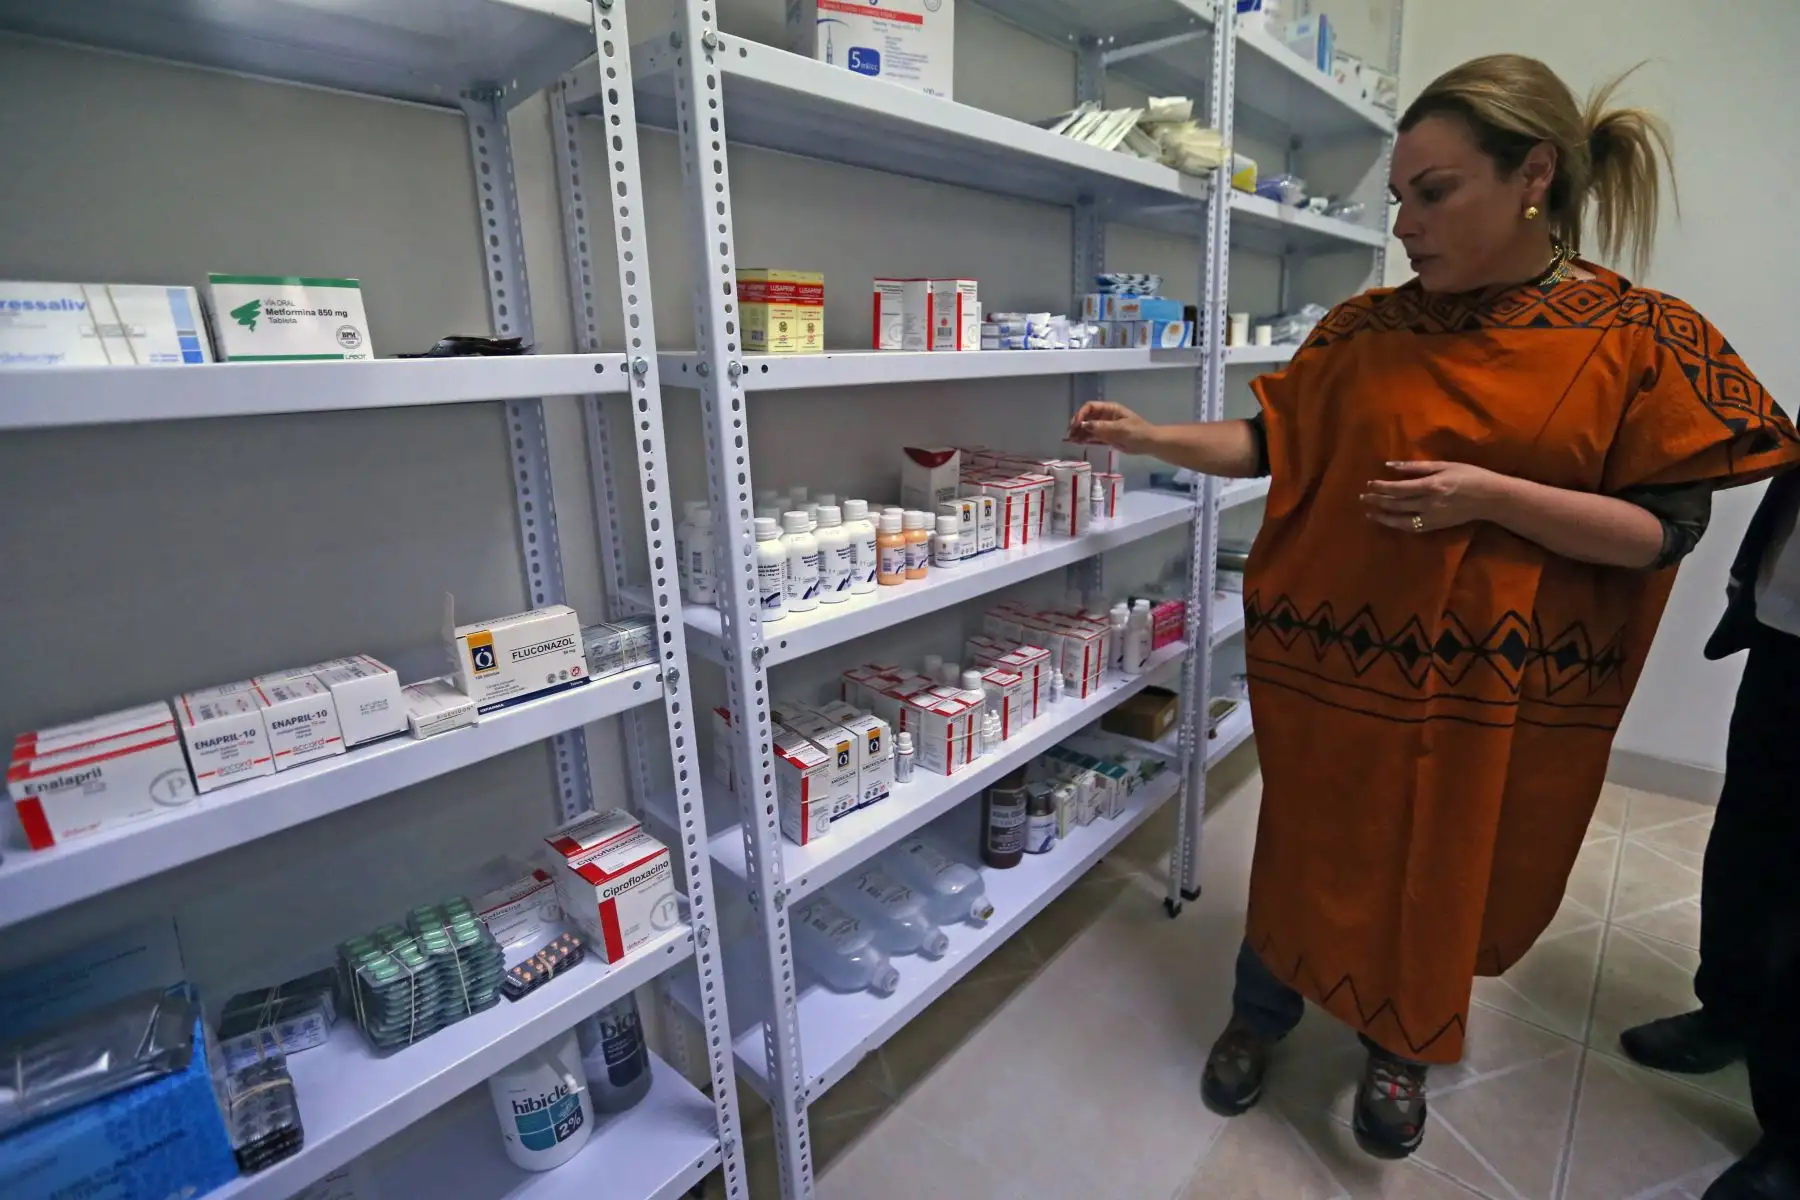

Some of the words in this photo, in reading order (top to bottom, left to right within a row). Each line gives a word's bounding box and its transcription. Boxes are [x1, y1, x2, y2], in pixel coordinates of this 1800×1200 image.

[851, 51, 861, 69] 5
[265, 308, 316, 316] Metformina
[317, 308, 333, 317] 850
[335, 310, 348, 318] mg
[511, 636, 575, 660] FLUCONAZOL
[272, 709, 328, 730] ENAPRIL-10
[194, 728, 256, 750] ENAPRIL-10
[24, 766, 102, 796] Enalapril
[602, 860, 669, 899] Ciprofloxacino
[559, 1113, 582, 1139] 2%
